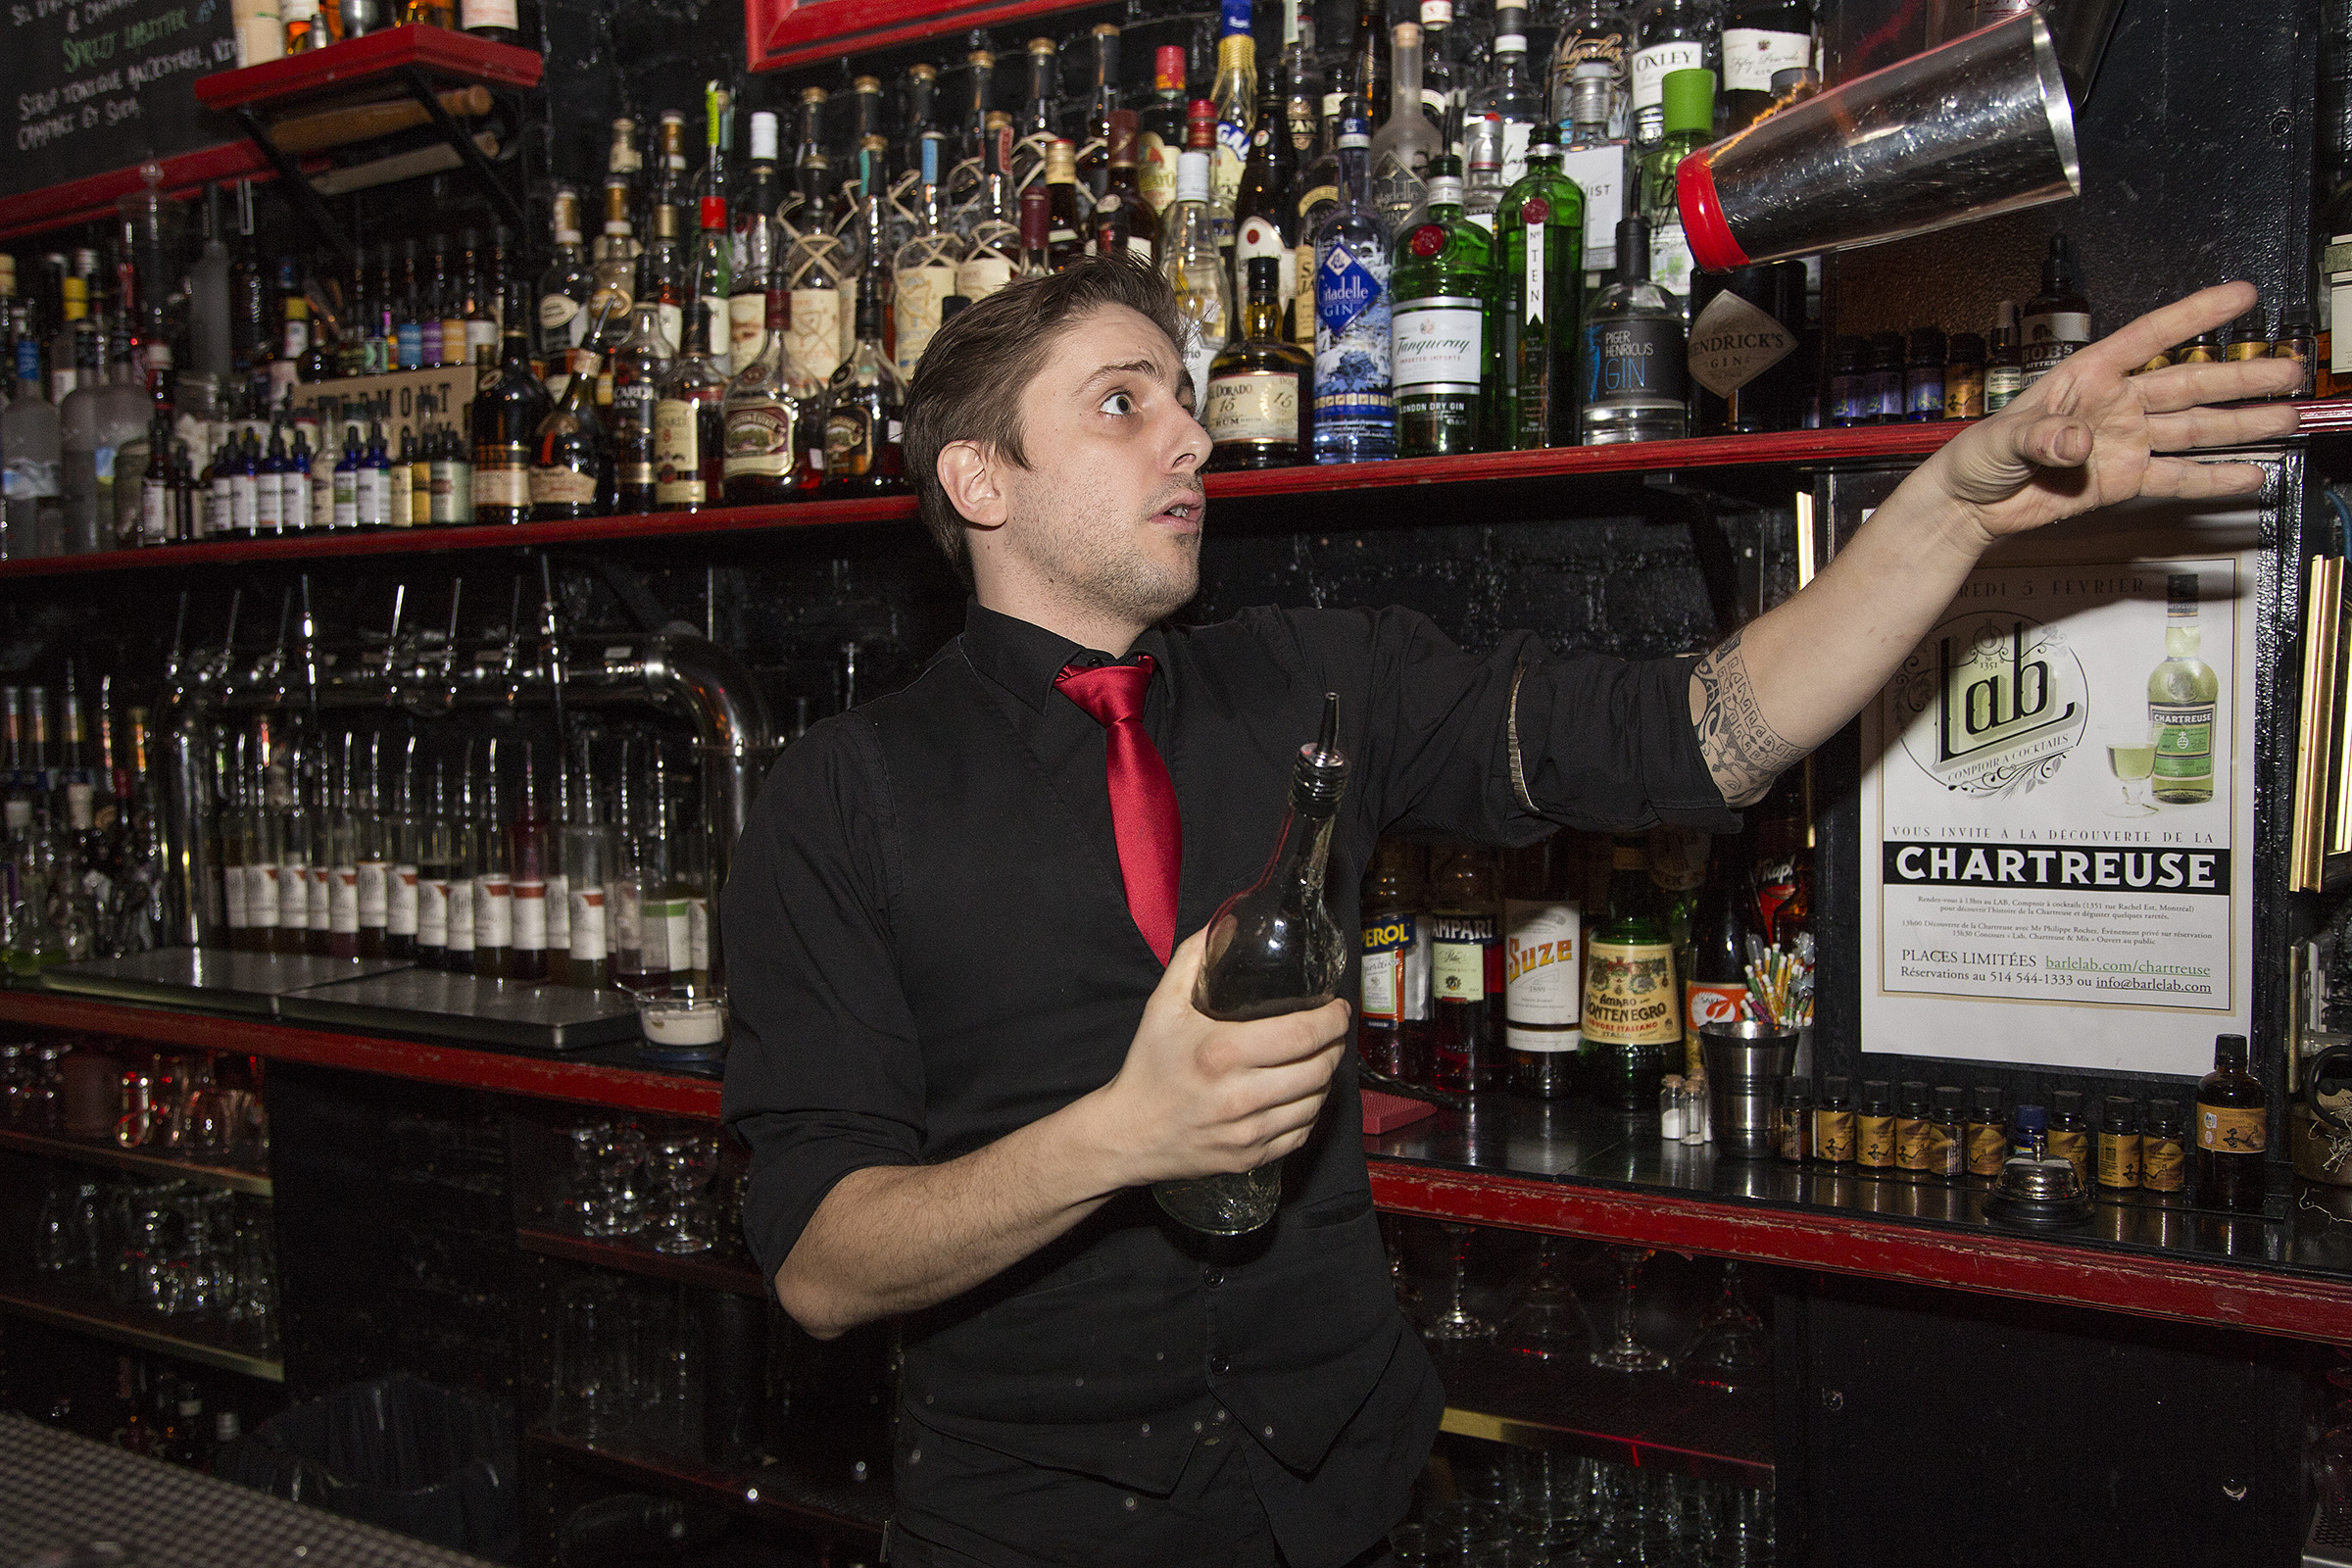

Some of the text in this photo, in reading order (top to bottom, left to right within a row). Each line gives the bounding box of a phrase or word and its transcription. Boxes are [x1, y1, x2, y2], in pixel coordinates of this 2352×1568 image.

[1636, 51, 1693, 73] OXLEY
[1531, 249, 1540, 302] TEN
[1323, 303, 1353, 318] GIN
[1397, 336, 1471, 355] Tanqueray
[1605, 330, 1632, 345] PIGER
[1690, 333, 1784, 357] ENDRICK'S
[1605, 342, 1654, 358] HENRICUS
[1711, 356, 1742, 368] GIN
[1604, 357, 1645, 390] GIN
[1216, 383, 1252, 398] DORADO
[1399, 401, 1465, 414] LONDON DRY GIN
[1959, 582, 2006, 597] REDI
[1939, 621, 2076, 761] Lab
[2154, 712, 2212, 723] CHARTREUSE
[1948, 758, 2000, 782] COMPTOIR
[2012, 734, 2070, 760] COCKTAILS
[1892, 826, 1931, 837] VOUS
[1941, 827, 1990, 838] INVITE
[2020, 829, 2037, 840] LA
[2049, 829, 2151, 842] DÉCOUVERTE
[2163, 832, 2182, 843] DE
[2195, 832, 2214, 844] LA
[1896, 846, 2216, 888] CHARTREUSE
[1433, 919, 1493, 939] AMPARI
[1902, 949, 2211, 977] PLACES LIMITÉES barlelab.com/chartreuse
[1901, 966, 1970, 980] Réservations
[1990, 971, 2011, 983] 514
[2016, 972, 2073, 986] 544-1333
[2077, 978, 2092, 987] ou
[2096, 976, 2212, 994] info@barlelab.com
[1616, 1021, 1658, 1032] ITALIANO
